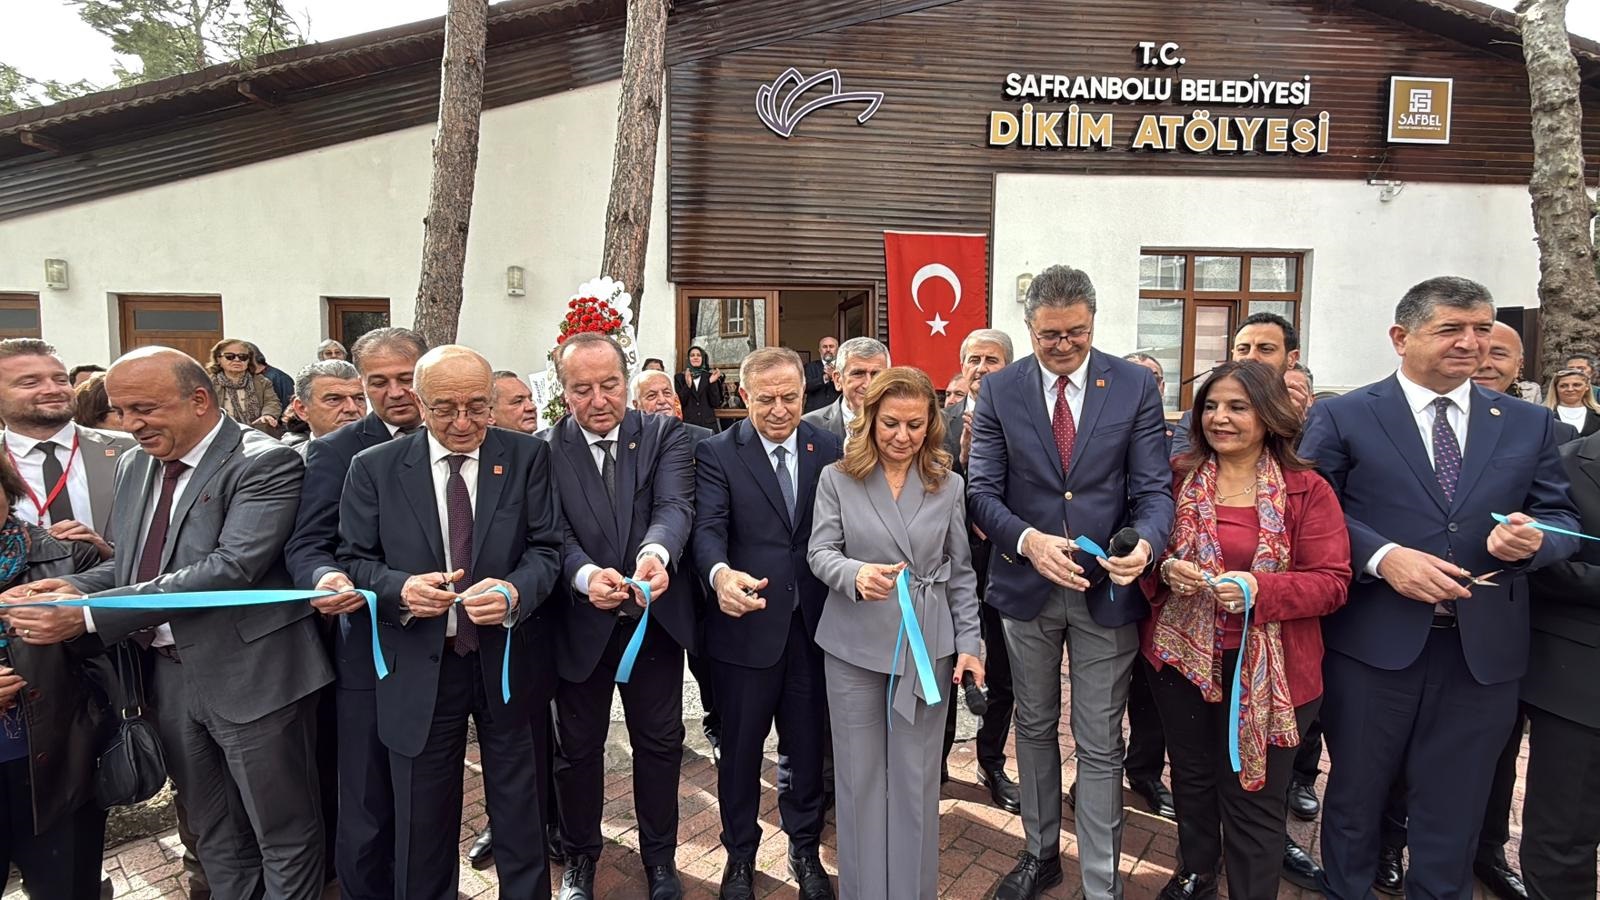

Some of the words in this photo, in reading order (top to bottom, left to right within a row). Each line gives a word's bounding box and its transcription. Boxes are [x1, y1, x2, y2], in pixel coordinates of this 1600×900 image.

[1139, 41, 1186, 66] T.C.
[1005, 72, 1172, 101] SAFRANBOLU
[1181, 73, 1311, 105] BELEDİYESİ
[989, 102, 1114, 148] DİKİM
[1132, 109, 1330, 154] ATÖLYESİ
[1398, 113, 1442, 127] SAFBEL
